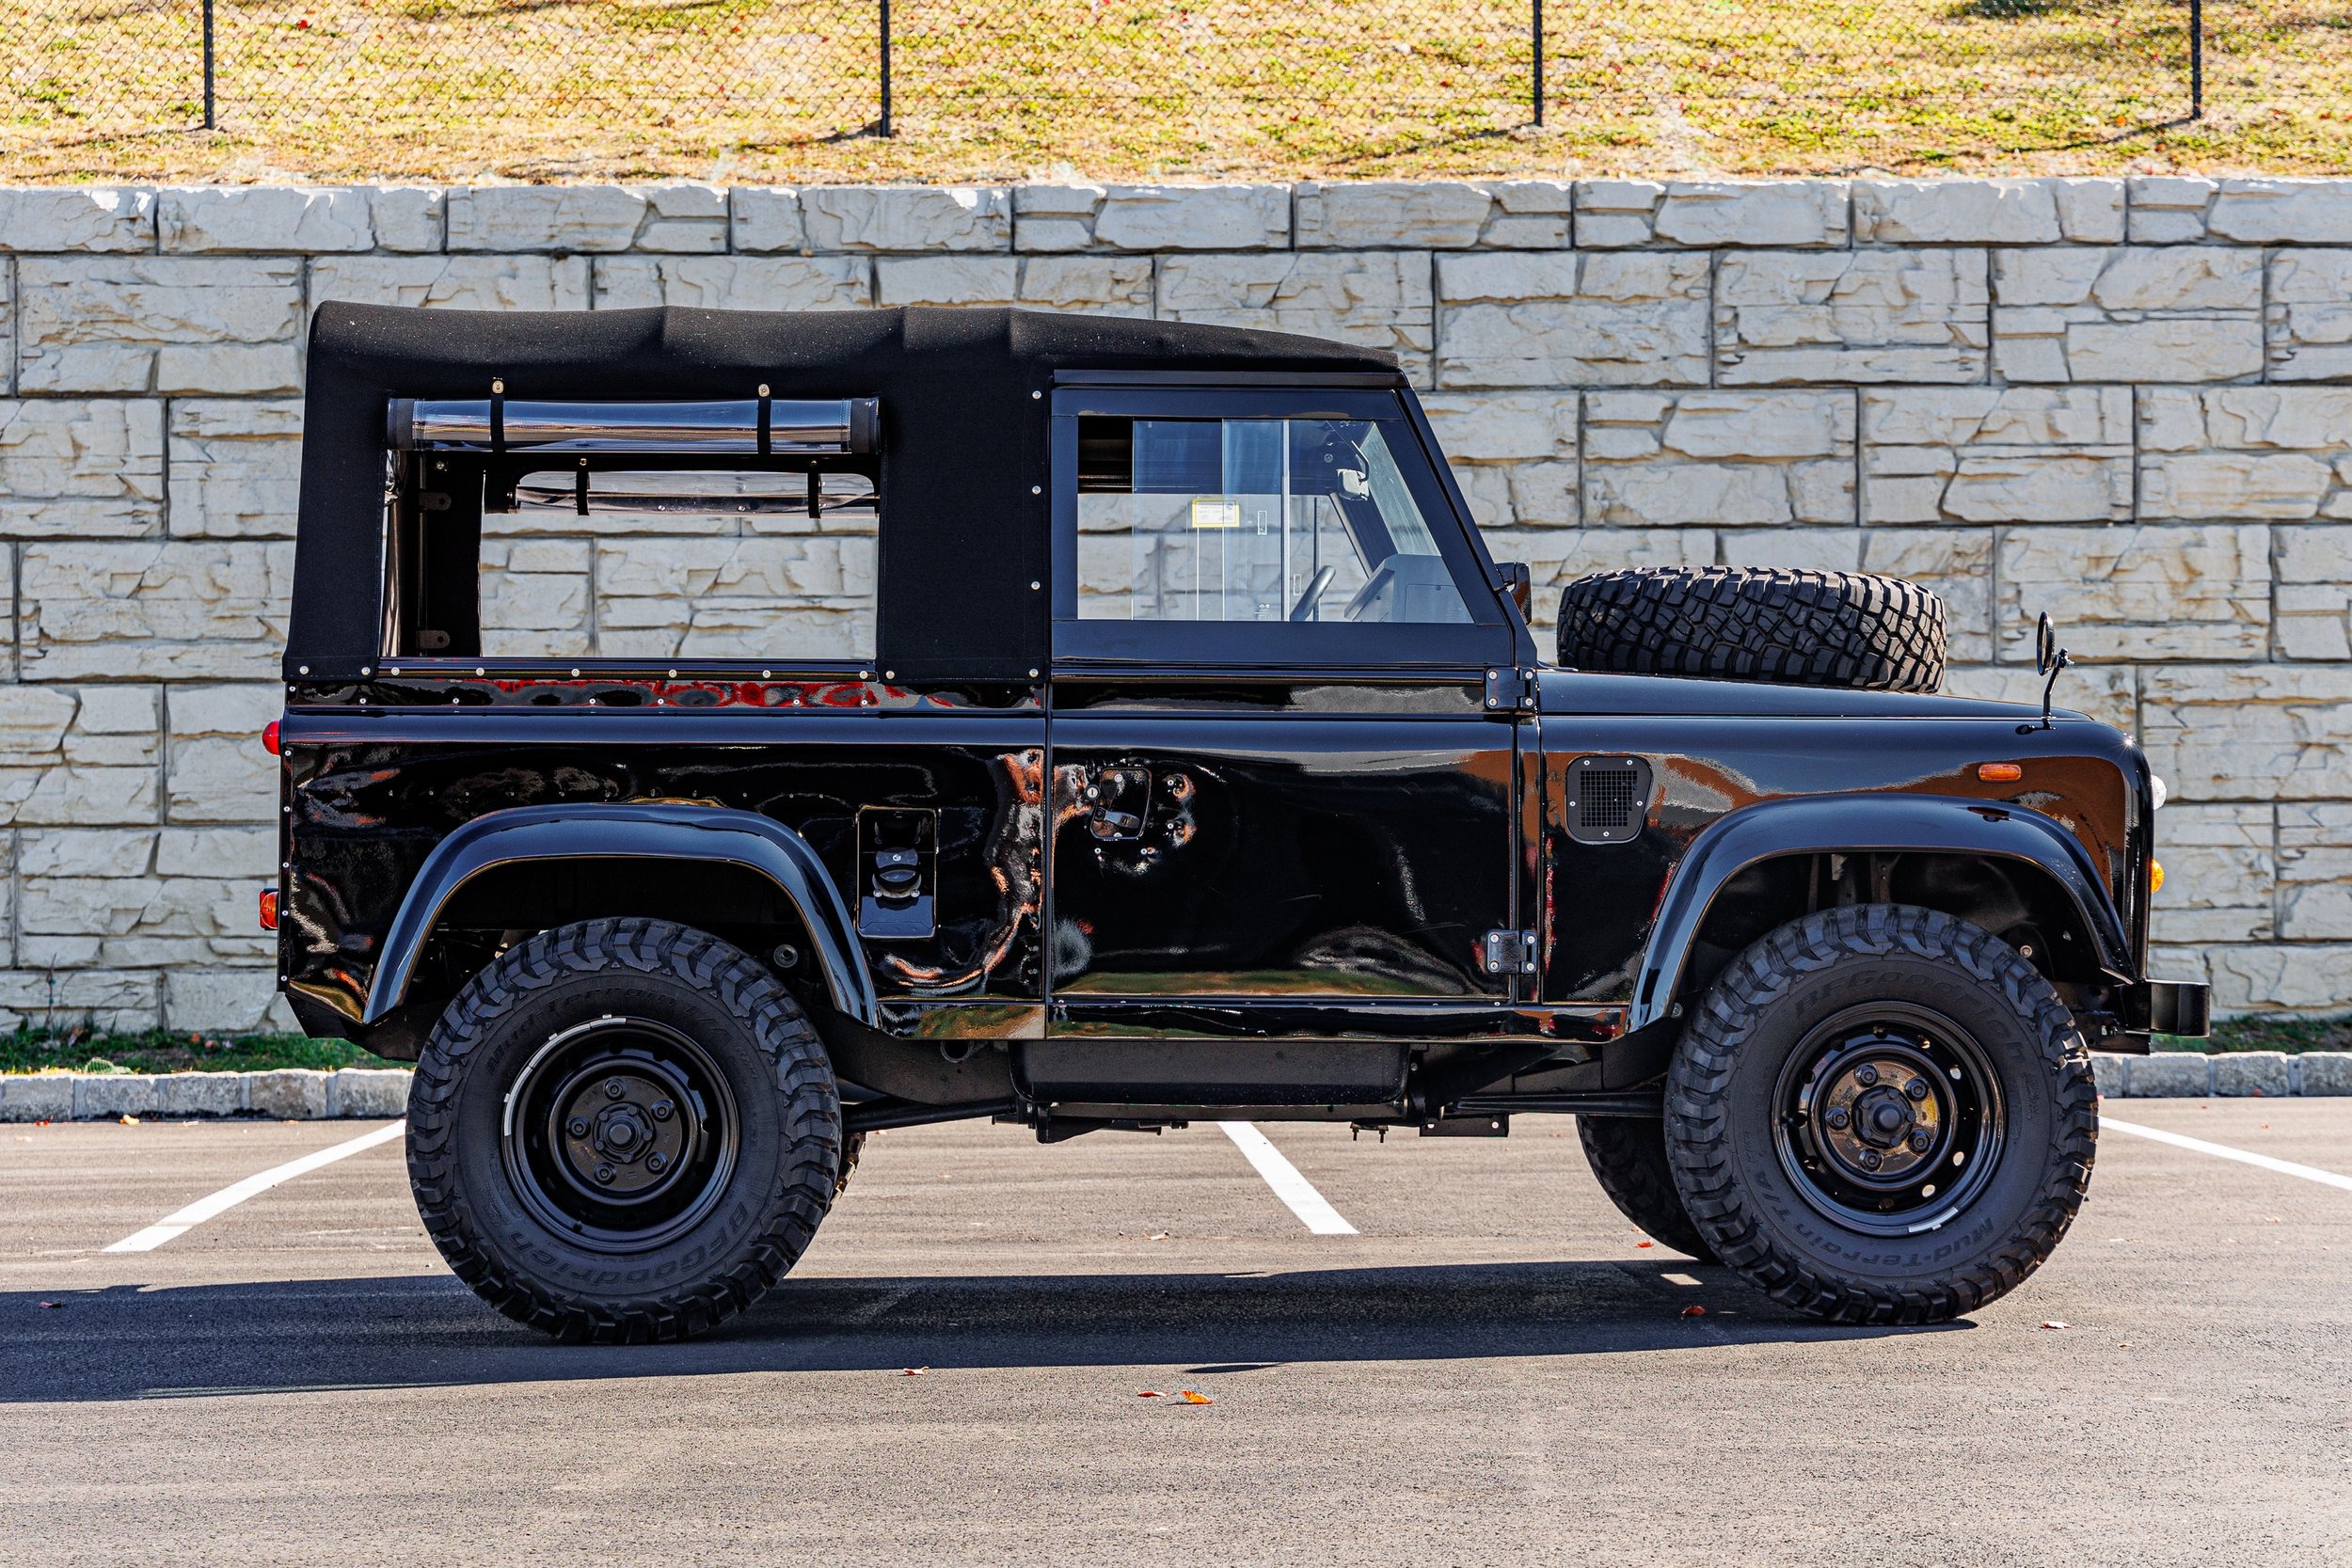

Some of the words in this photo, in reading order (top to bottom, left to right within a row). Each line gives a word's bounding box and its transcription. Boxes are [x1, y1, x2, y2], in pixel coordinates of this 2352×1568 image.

[486, 985, 677, 1074] Mud-Terrain
[684, 1003, 733, 1045] T/A
[1794, 969, 2027, 1065] BFGoodrich
[1753, 1171, 1790, 1223] T/A
[510, 1200, 749, 1286] BFGoodrich
[1790, 1216, 1994, 1268] Mud-Terrain
